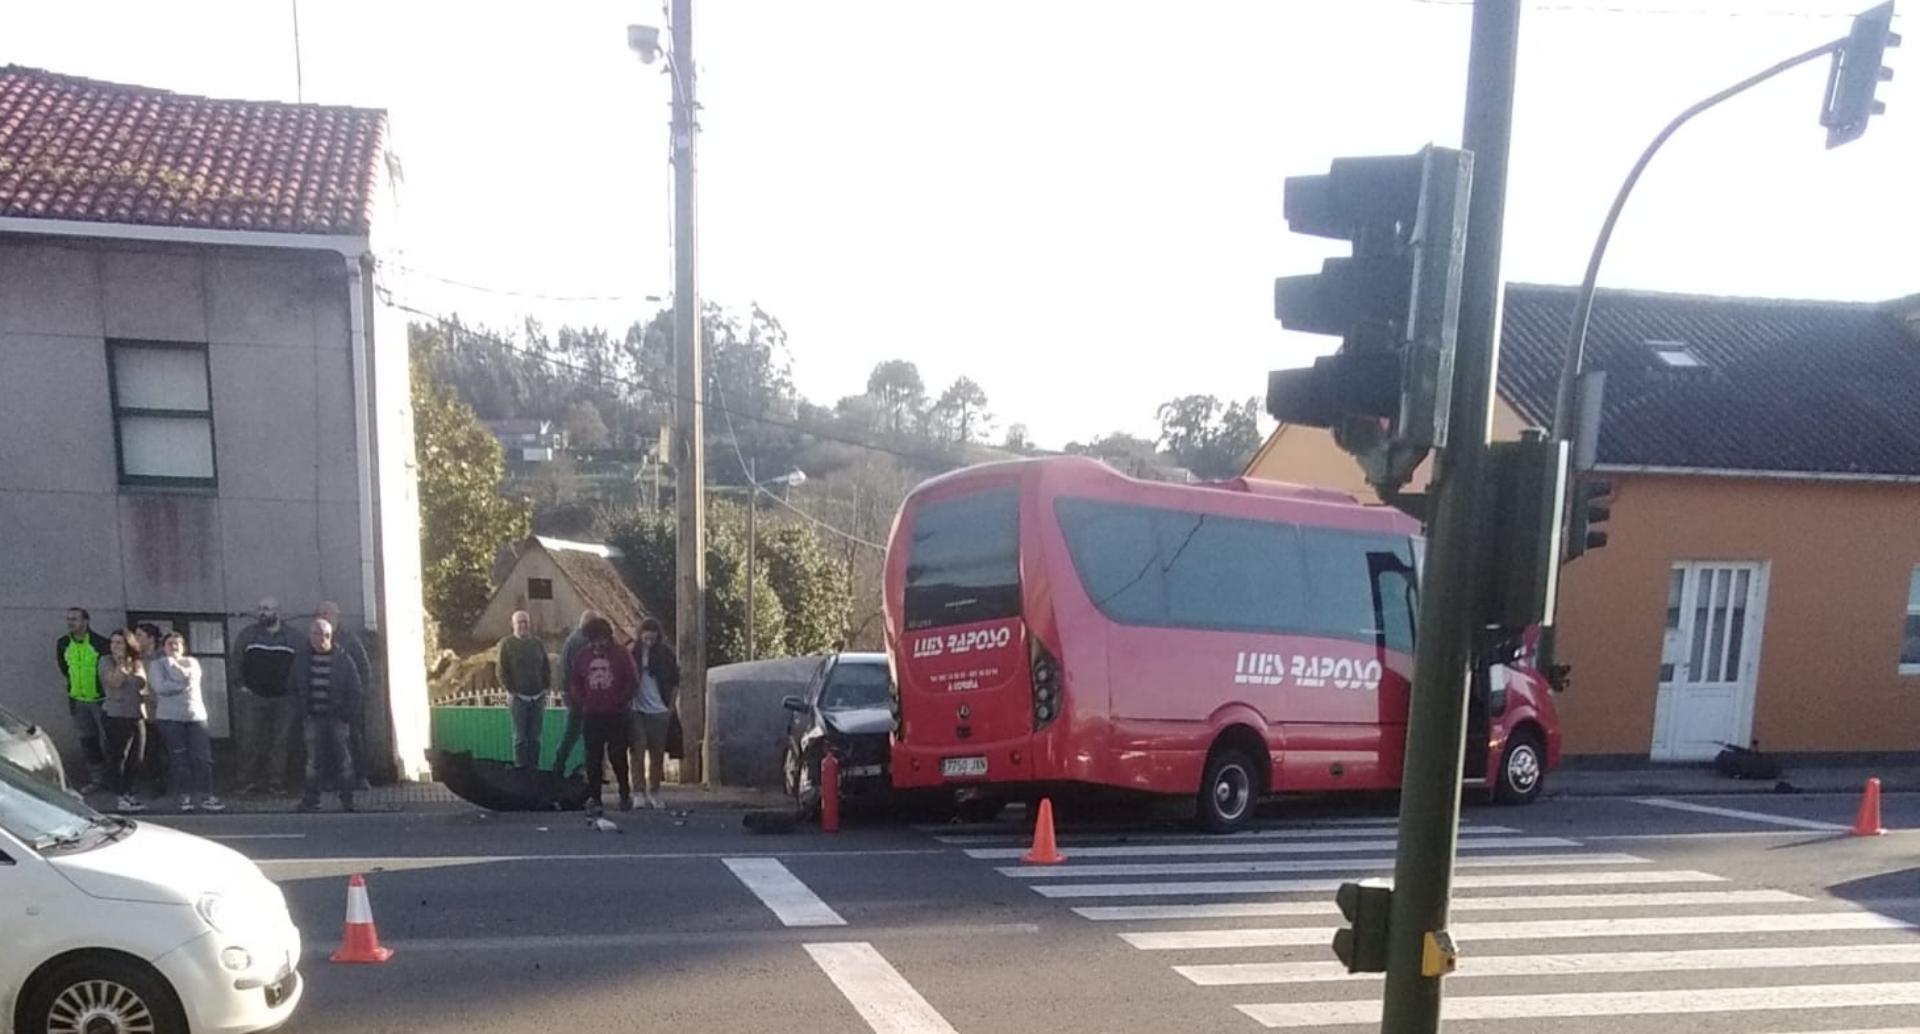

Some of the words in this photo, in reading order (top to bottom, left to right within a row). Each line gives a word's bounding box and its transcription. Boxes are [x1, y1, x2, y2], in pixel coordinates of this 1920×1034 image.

[913, 635, 944, 658] LUIS
[947, 626, 1010, 654] RAPOSO
[1234, 652, 1285, 685] LUIS
[1290, 655, 1382, 690] RAPOSO
